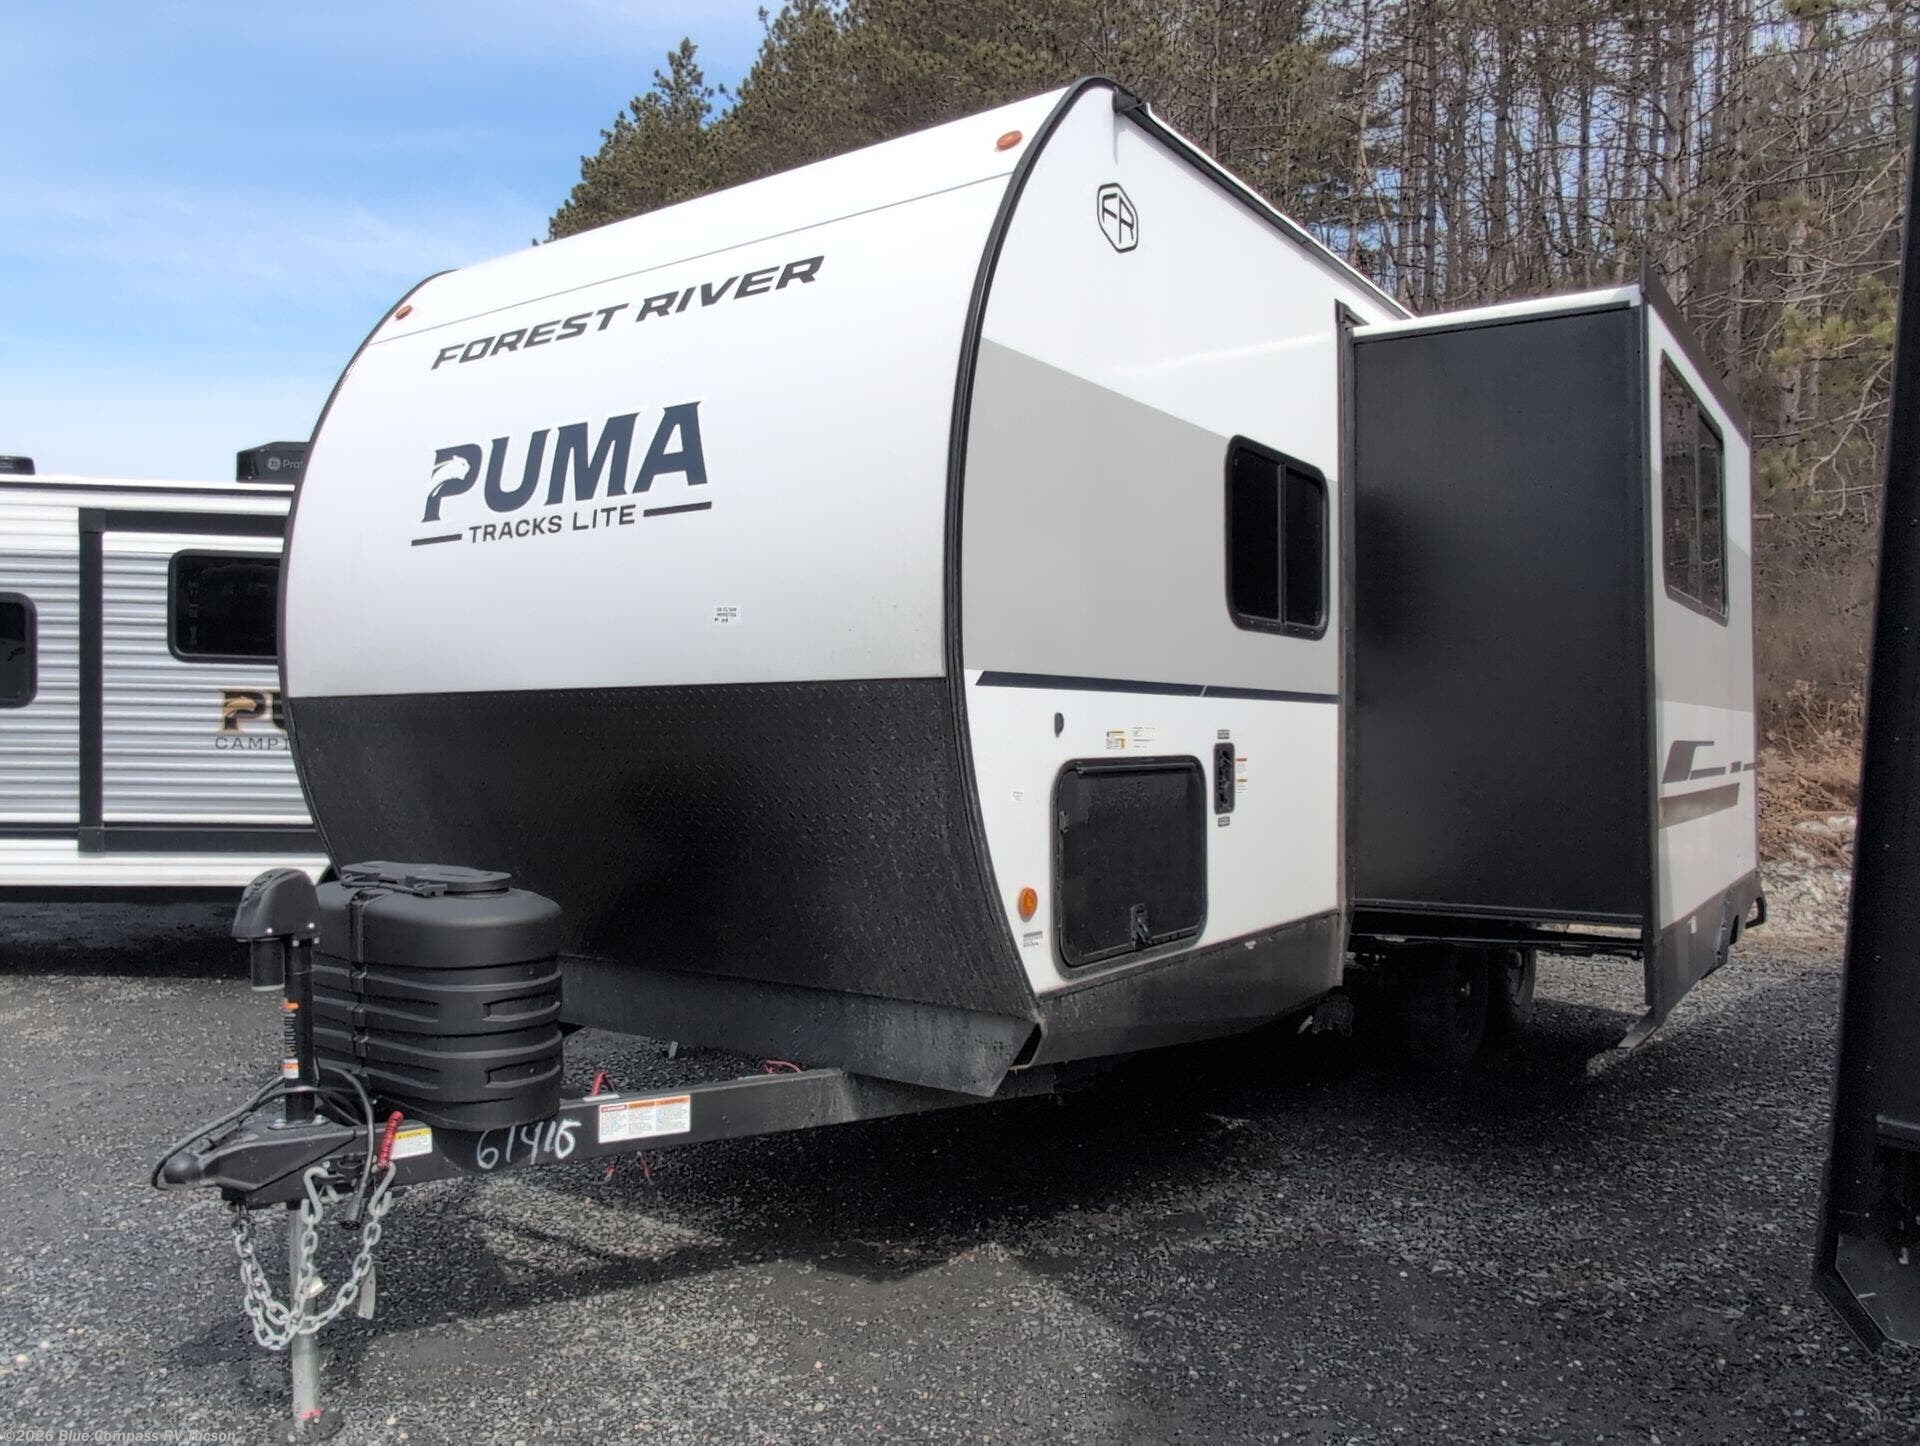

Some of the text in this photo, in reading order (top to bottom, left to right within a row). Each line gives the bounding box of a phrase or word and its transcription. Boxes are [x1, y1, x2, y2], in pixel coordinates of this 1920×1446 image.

[431, 255, 825, 370] FOREST RIVER
[421, 401, 708, 523] PUMA
[468, 504, 637, 544] TRACKS LITE
